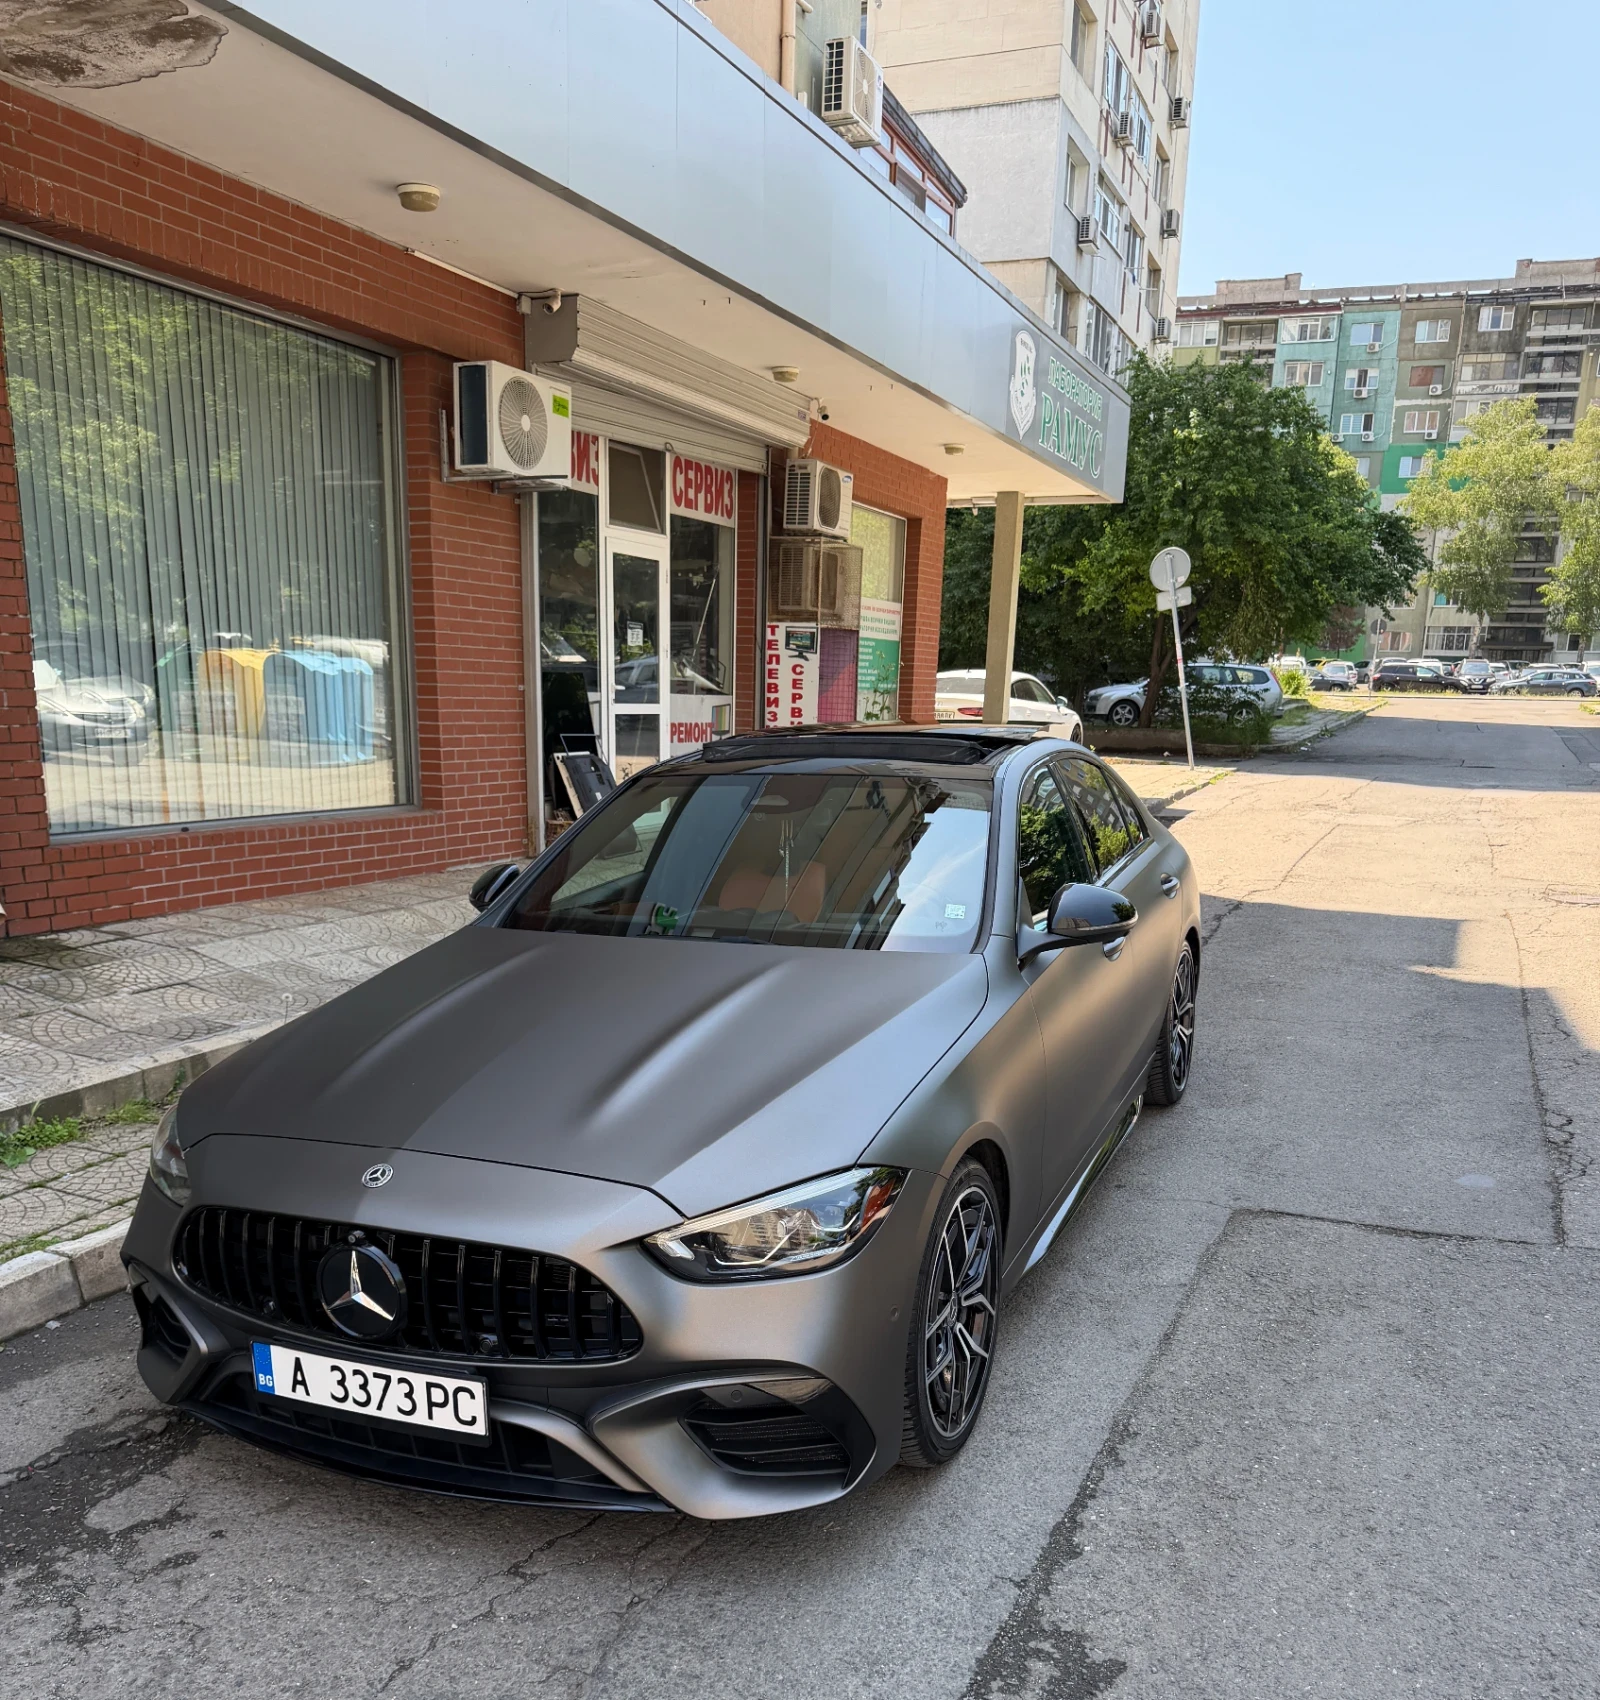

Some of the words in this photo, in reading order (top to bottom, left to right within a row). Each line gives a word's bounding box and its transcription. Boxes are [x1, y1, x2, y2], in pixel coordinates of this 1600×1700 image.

[1048, 356, 1103, 422] ЛАБОРАТОРИЯ
[1038, 391, 1103, 479] РАМУС
[672, 455, 734, 520] СЕРВИЗ
[766, 624, 781, 729] ТЕЛЕВИЗ
[670, 722, 714, 743] РЕМОНТ
[258, 1373, 274, 1388] BG
